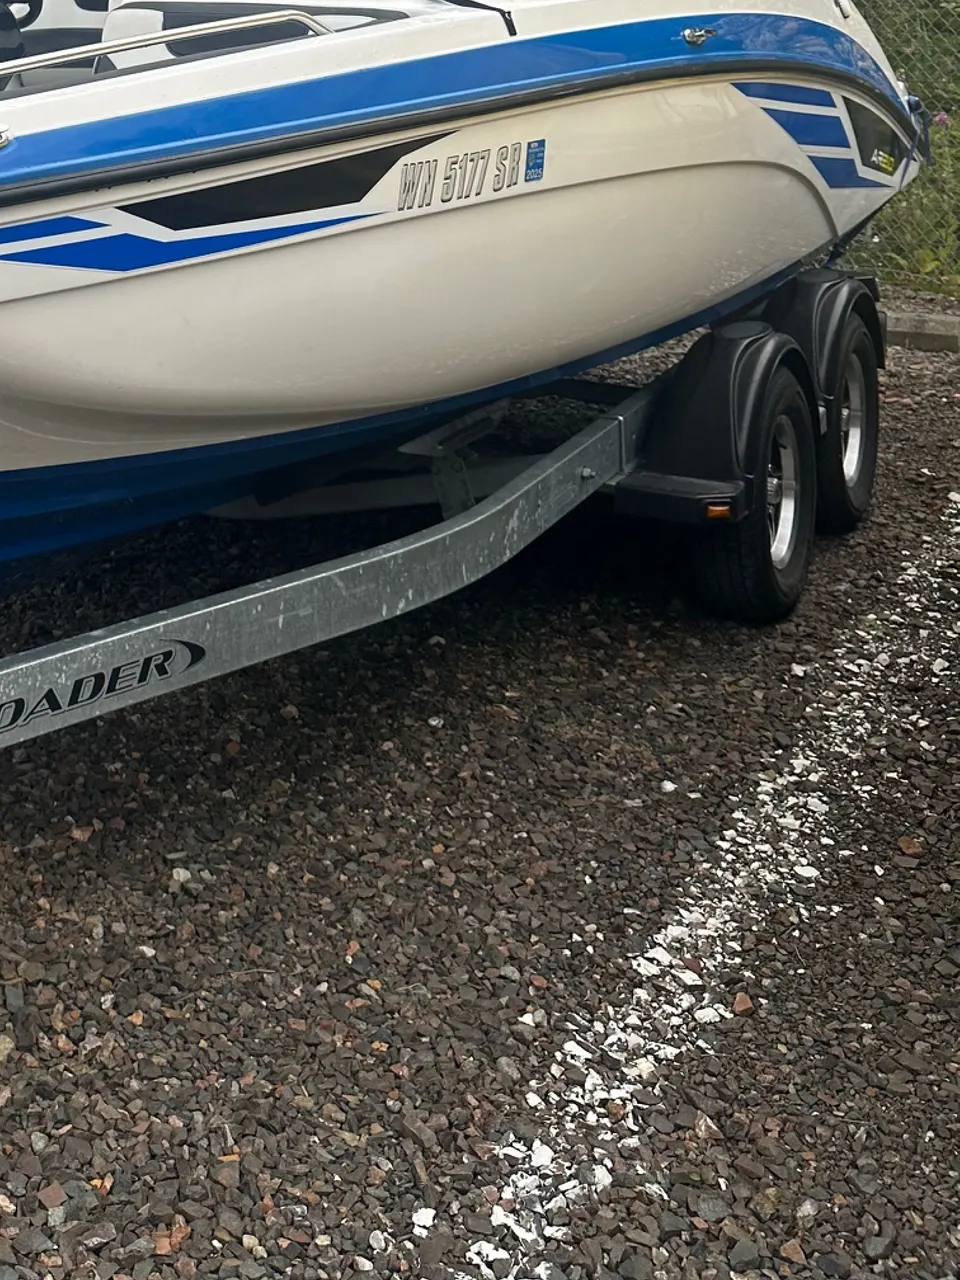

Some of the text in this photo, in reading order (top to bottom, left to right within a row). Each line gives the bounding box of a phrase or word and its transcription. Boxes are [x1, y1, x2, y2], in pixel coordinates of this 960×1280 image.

[397, 142, 522, 211] WN 5177 SR
[526, 167, 543, 180] 2025
